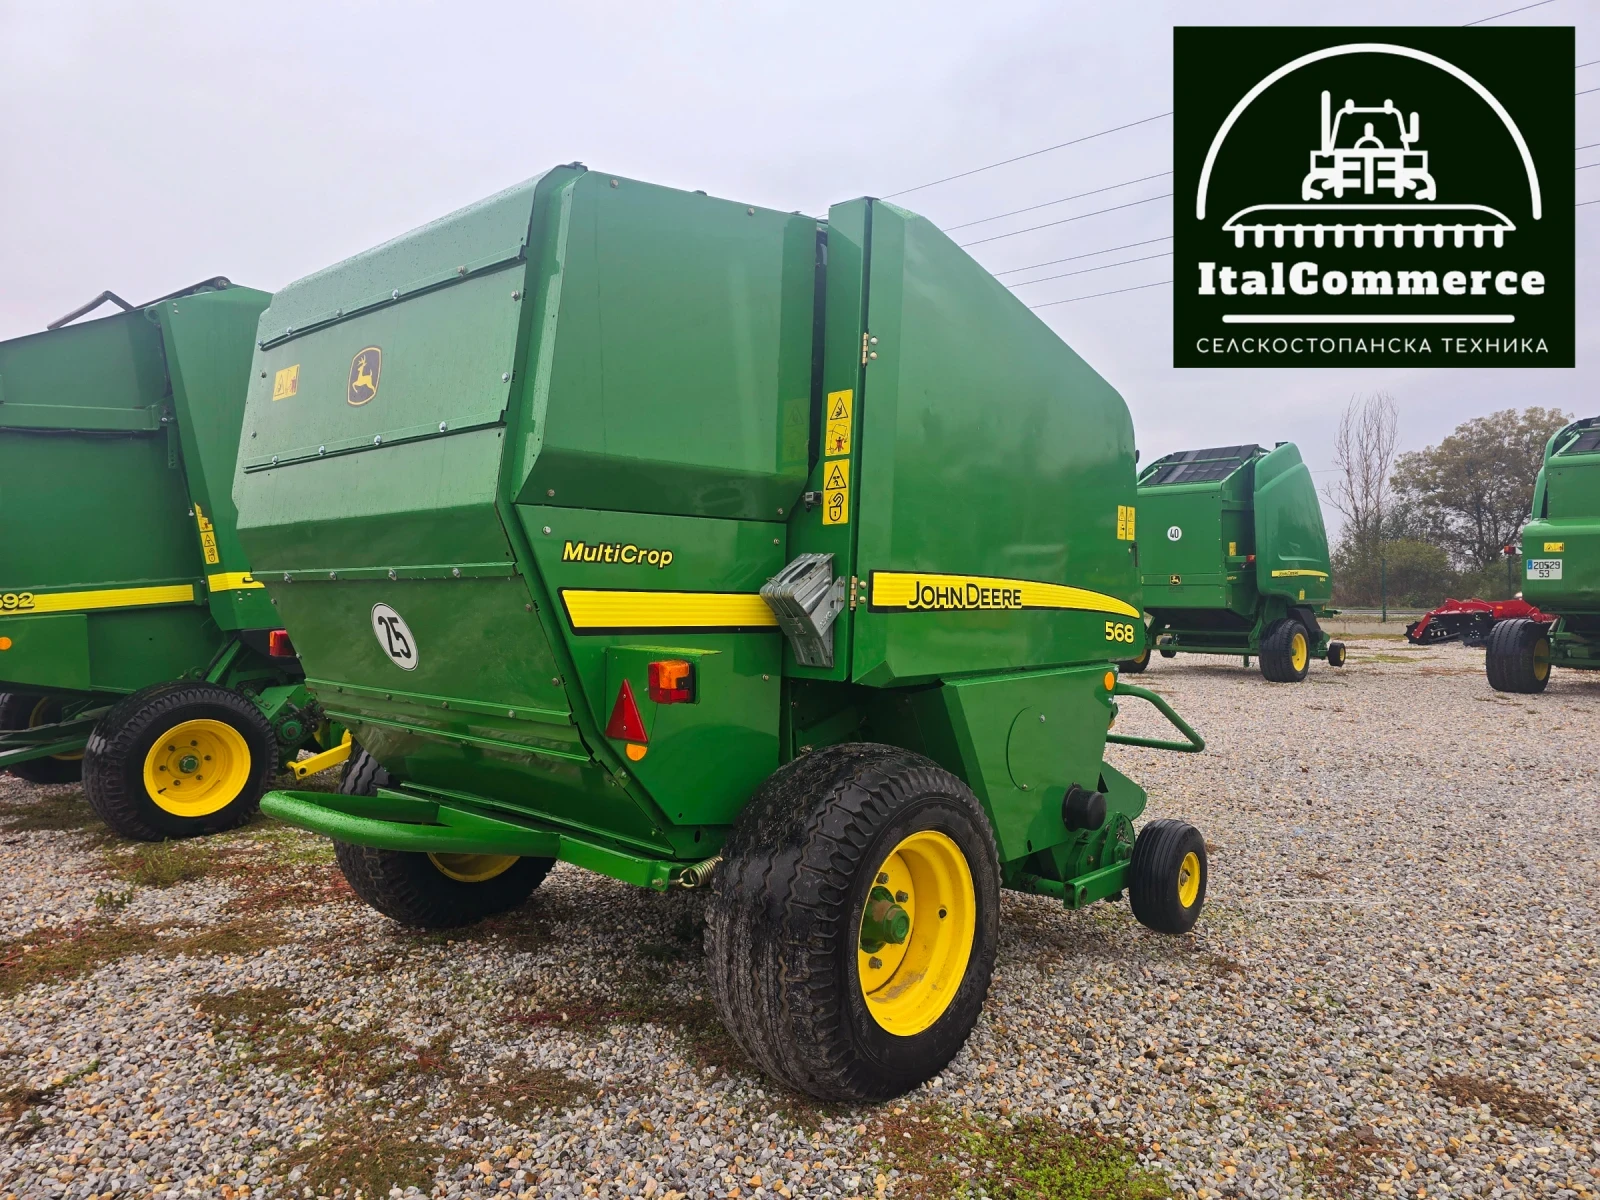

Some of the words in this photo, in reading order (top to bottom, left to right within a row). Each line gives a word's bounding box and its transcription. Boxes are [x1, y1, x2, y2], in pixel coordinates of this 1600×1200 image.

[1169, 528, 1180, 539] 40
[562, 540, 674, 569] MultiCrop
[1533, 561, 1561, 570] 20529
[1539, 570, 1550, 578] 53
[0, 592, 35, 609] 92
[908, 580, 963, 607] JOHN
[965, 583, 1023, 608] DEERE
[377, 615, 412, 659] 25
[1105, 621, 1135, 644] 568
